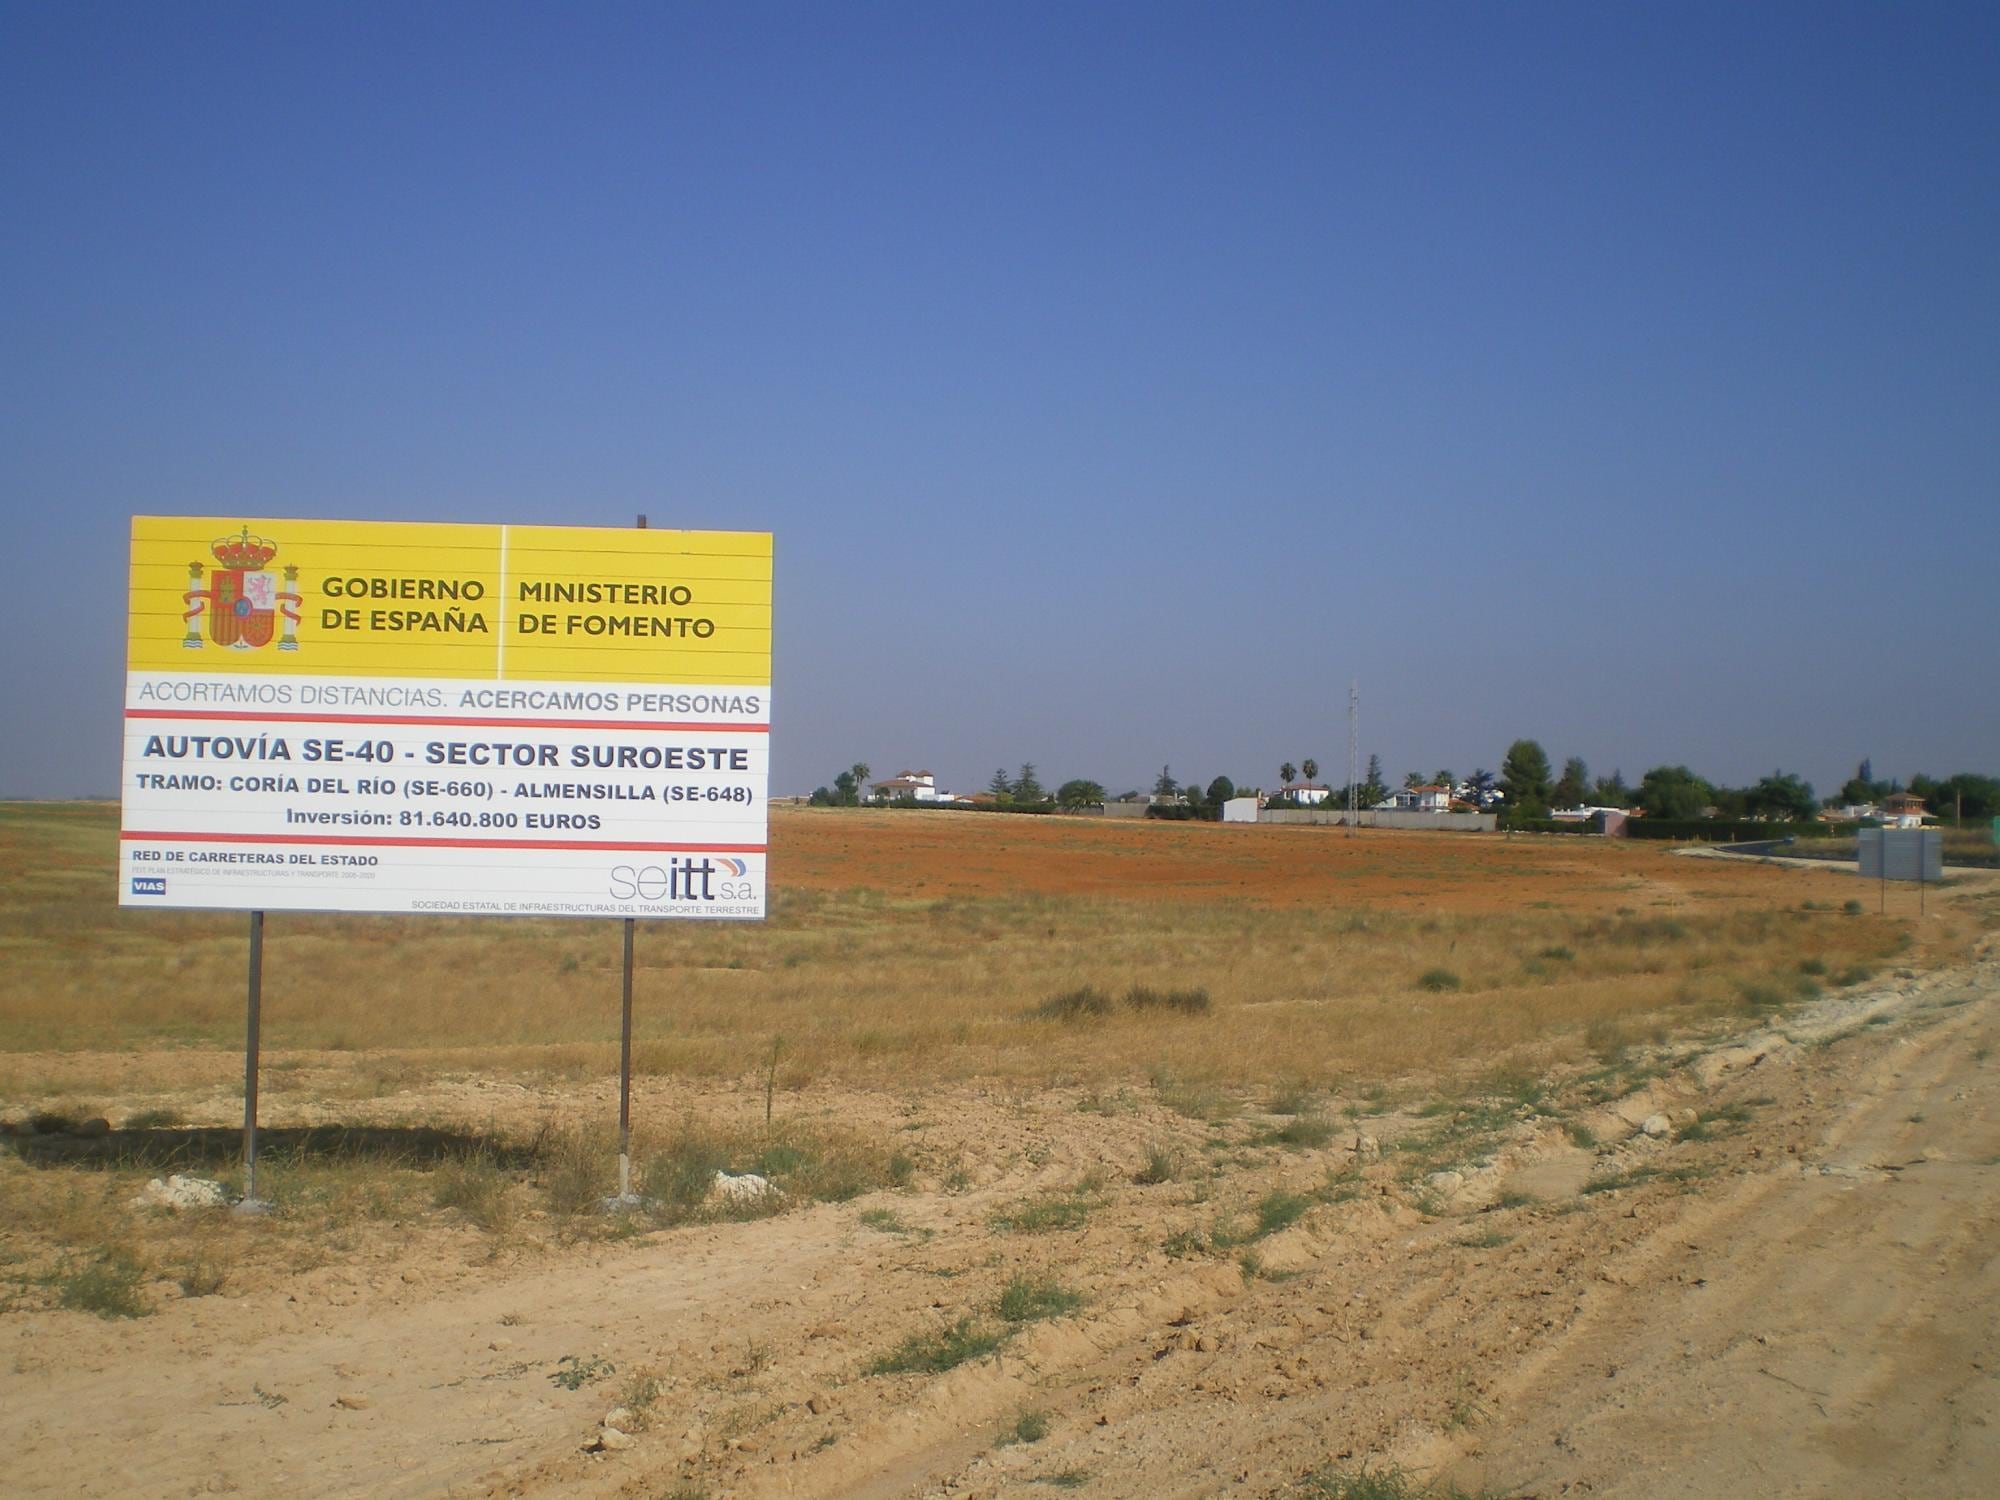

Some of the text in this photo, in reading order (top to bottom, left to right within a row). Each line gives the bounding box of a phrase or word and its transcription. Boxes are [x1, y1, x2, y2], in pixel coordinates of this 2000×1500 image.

[322, 577, 484, 601] GOBIERNO
[519, 581, 692, 606] MINISTERIO
[321, 606, 488, 633] DE ESPAÑA
[518, 613, 715, 638] DE FOMENTO
[139, 681, 760, 714] ACORTAMOS DISTANCIAS. ACERCAMOS PERSONAS
[143, 733, 291, 760] AUTOVÍA
[302, 738, 394, 763] SE-40
[425, 740, 559, 767] SECTOR
[570, 745, 749, 770] SUROESTE
[136, 774, 222, 791] TRAMO:
[229, 774, 299, 793] CORÍA
[307, 778, 349, 795] DEL
[357, 776, 396, 795] RÍO
[403, 780, 493, 799] (SE-660)
[514, 782, 656, 801] ALMENSILLA
[663, 785, 753, 806] (SE-648)
[287, 808, 601, 829] Inversión: 81.640.800 EUROS
[133, 850, 378, 866] RED DE CARRETERAS DEL ESTADO
[134, 882, 165, 891] VIAS
[610, 857, 715, 900] seitt
[411, 900, 760, 915] SOCIEDAD ESTATAL DE INFRAESTRUCTURAS DEL TRANSPORTE TERRESTRE
